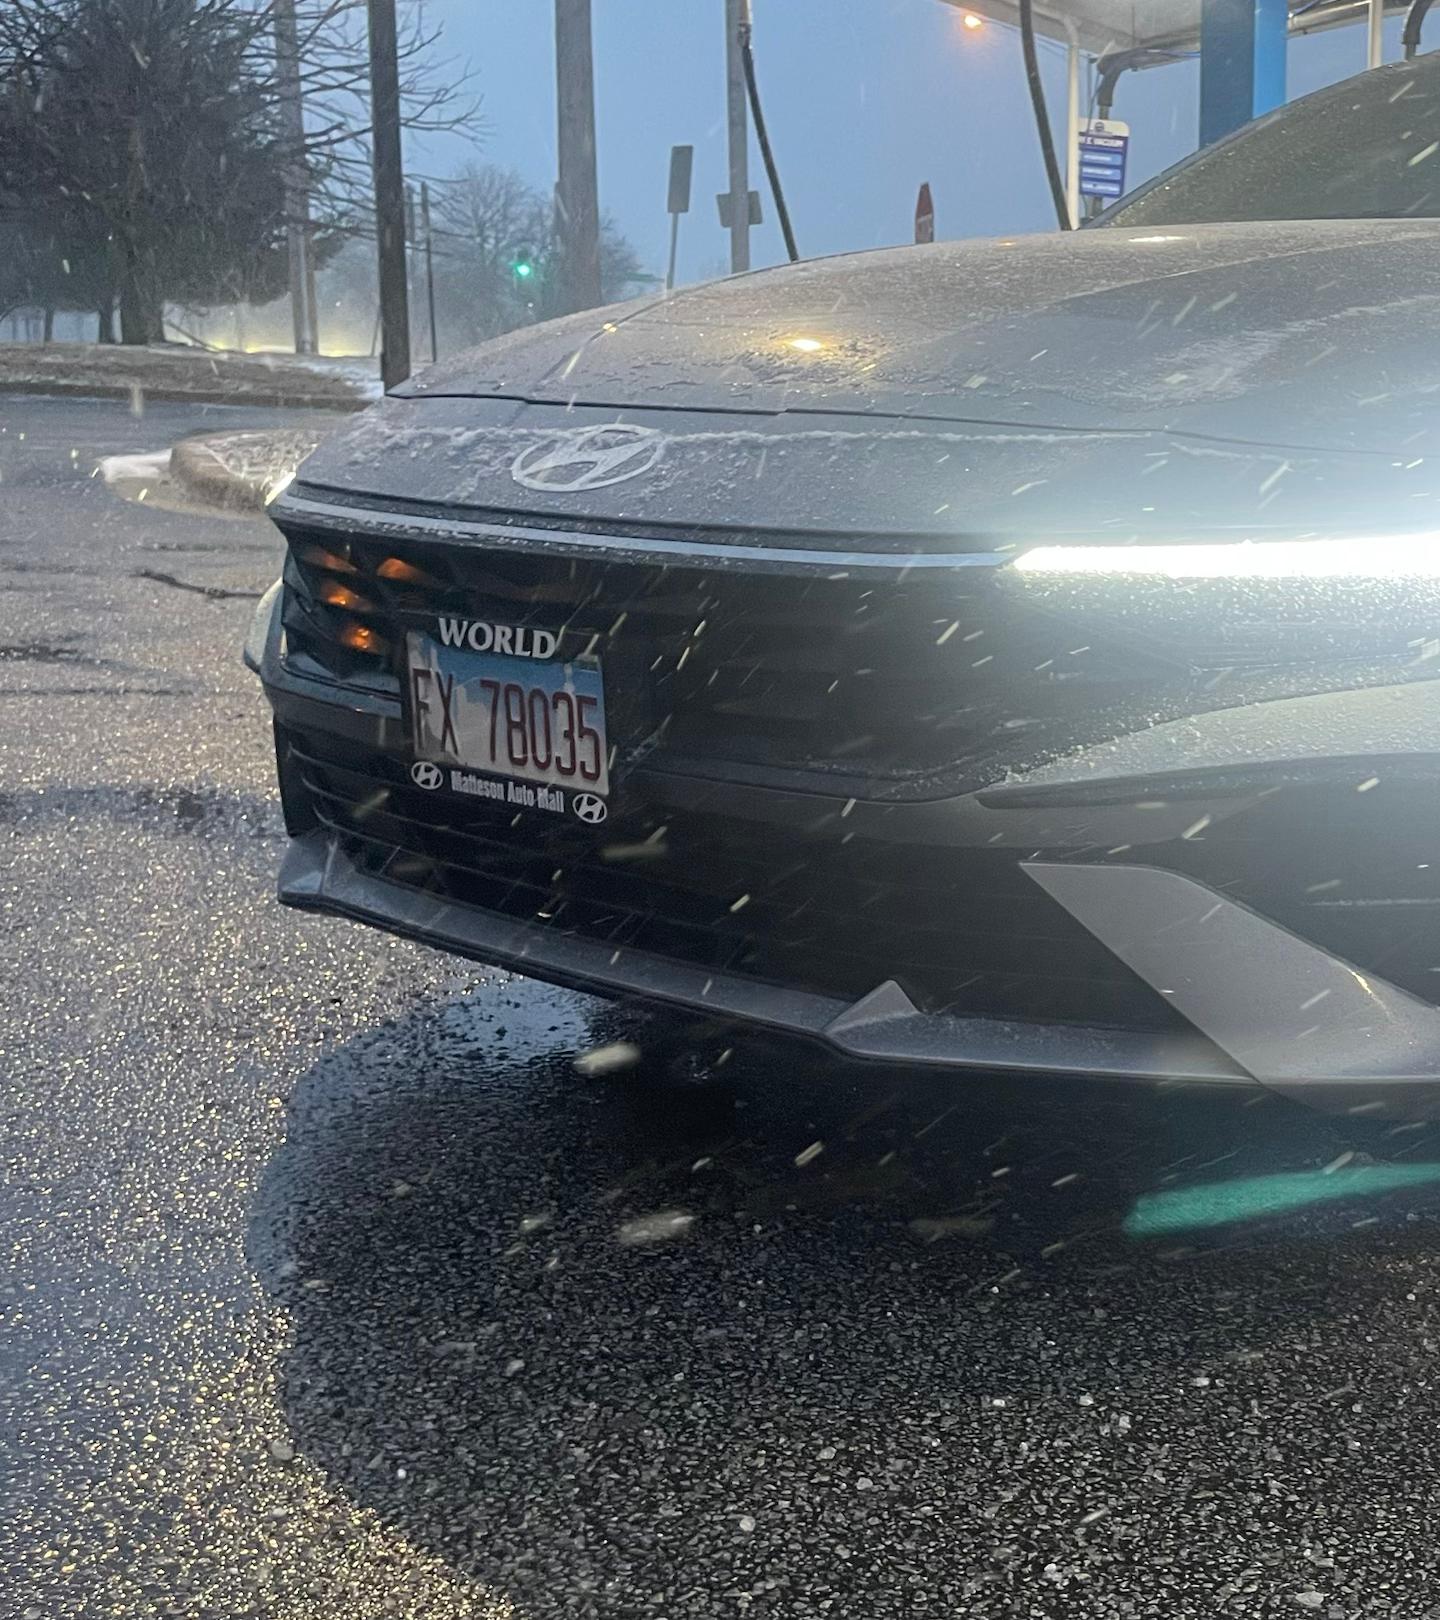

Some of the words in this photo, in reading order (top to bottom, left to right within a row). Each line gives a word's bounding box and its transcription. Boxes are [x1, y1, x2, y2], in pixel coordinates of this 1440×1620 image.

[438, 617, 556, 659] WORLD
[412, 667, 458, 755] FX
[480, 679, 600, 781] 78035
[451, 770, 504, 801] Matteson
[507, 781, 535, 807] Auto
[537, 787, 565, 813] Mall
